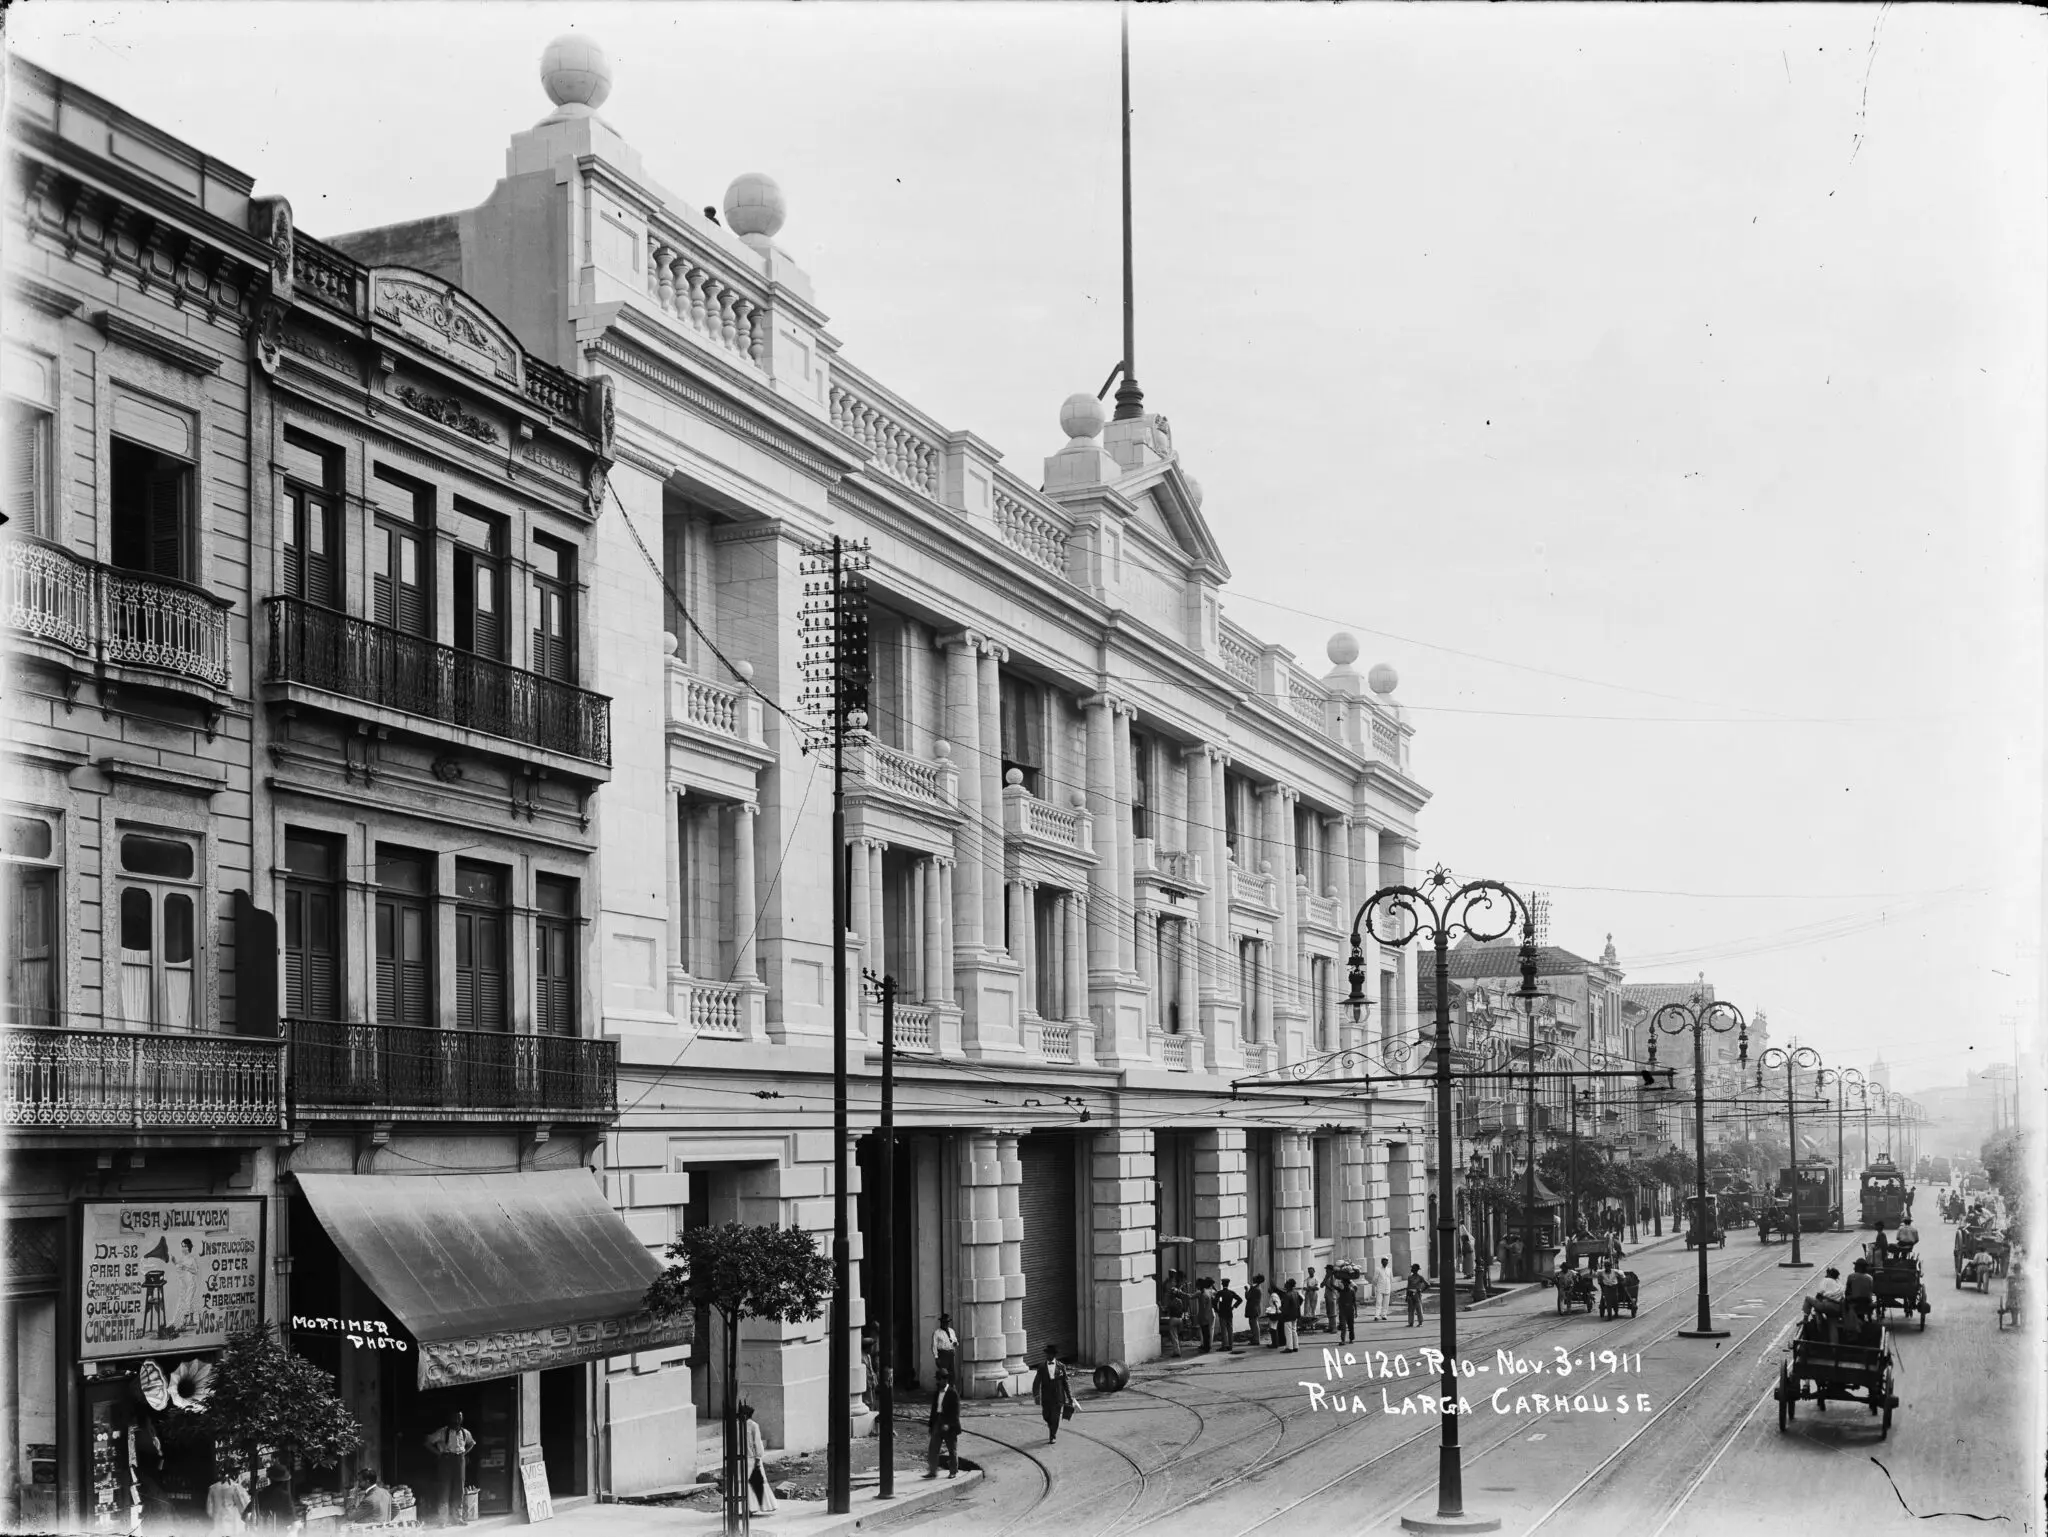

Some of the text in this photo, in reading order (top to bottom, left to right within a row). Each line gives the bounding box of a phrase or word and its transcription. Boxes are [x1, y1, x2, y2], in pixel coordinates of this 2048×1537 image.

[121, 1208, 228, 1231] CASA NEW YORK
[94, 1243, 138, 1259] DA-SE
[89, 1257, 248, 1279] PARA SE OBTER
[87, 1274, 255, 1300] GRAMOPHONES GRATIS
[86, 1292, 256, 1318] QUALQUER FABRICANTE
[550, 1350, 563, 1361] DE
[572, 1343, 604, 1357] TODAS
